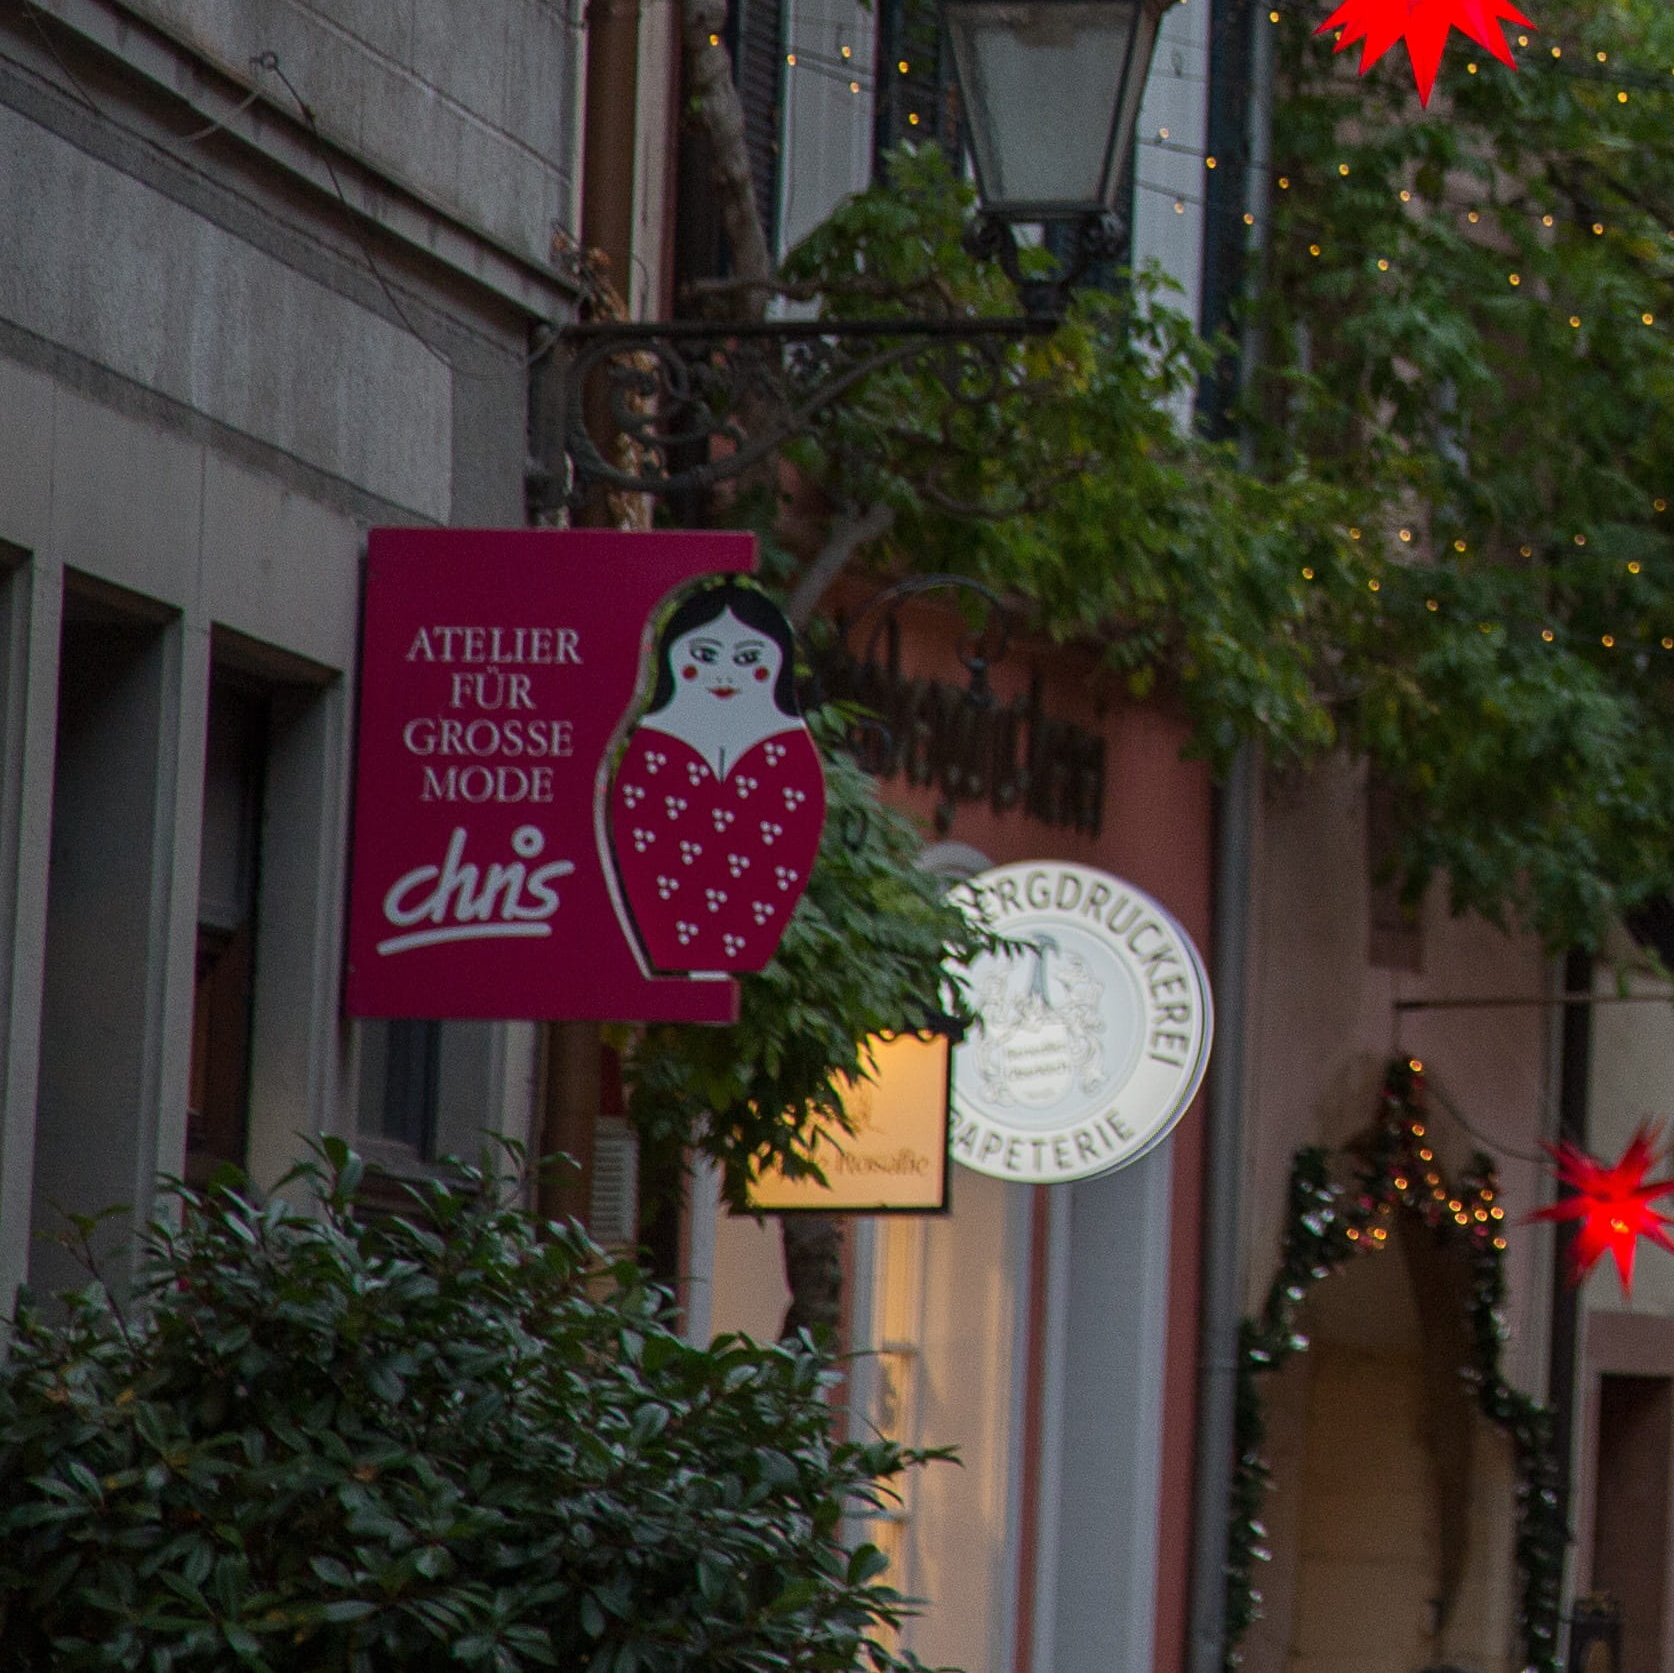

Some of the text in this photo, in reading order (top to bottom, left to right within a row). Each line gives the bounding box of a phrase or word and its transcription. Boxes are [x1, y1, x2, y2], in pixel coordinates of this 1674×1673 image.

[405, 626, 584, 664] ATELIER
[450, 665, 537, 710] FÜR
[403, 717, 575, 757] GROSSE
[420, 764, 555, 803] MODE
